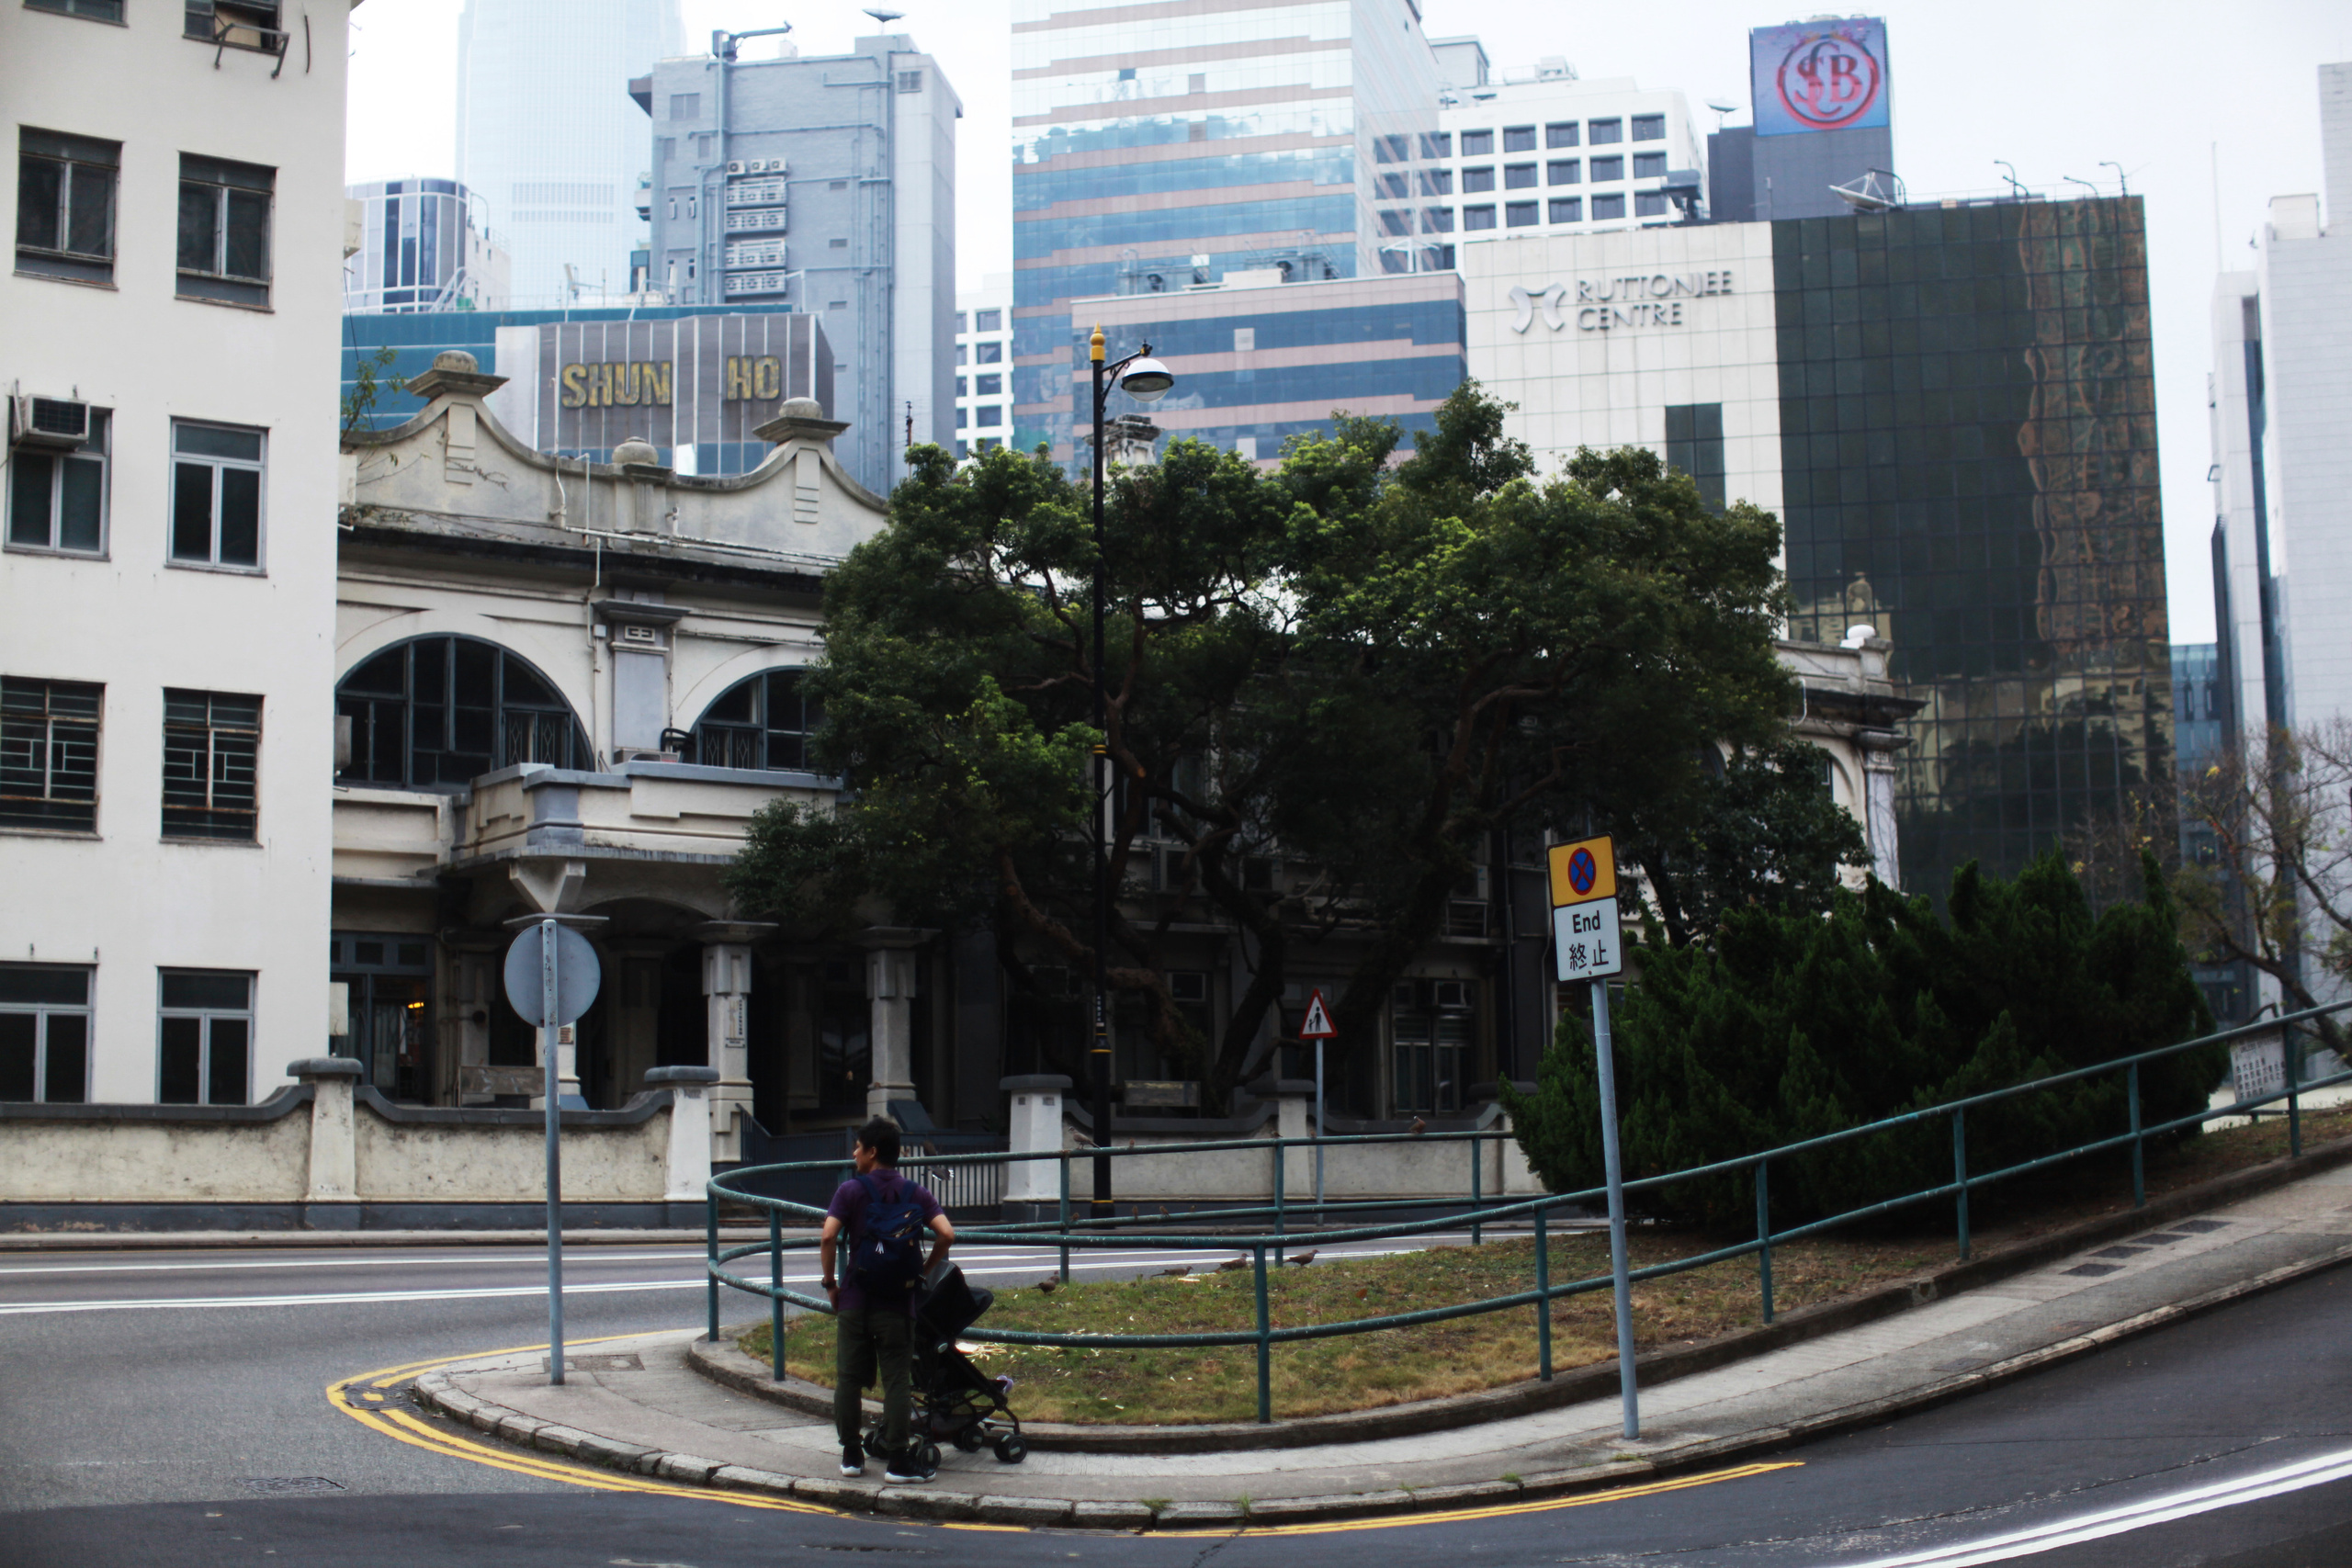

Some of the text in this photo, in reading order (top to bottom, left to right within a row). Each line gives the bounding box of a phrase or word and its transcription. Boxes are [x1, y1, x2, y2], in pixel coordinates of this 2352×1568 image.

[1577, 270, 1734, 303] RUTTONJEE
[1577, 302, 1682, 332] CENTRE
[560, 355, 781, 408] SHUN HO
[1572, 909, 1601, 934] End
[1568, 939, 1610, 972] 終止
